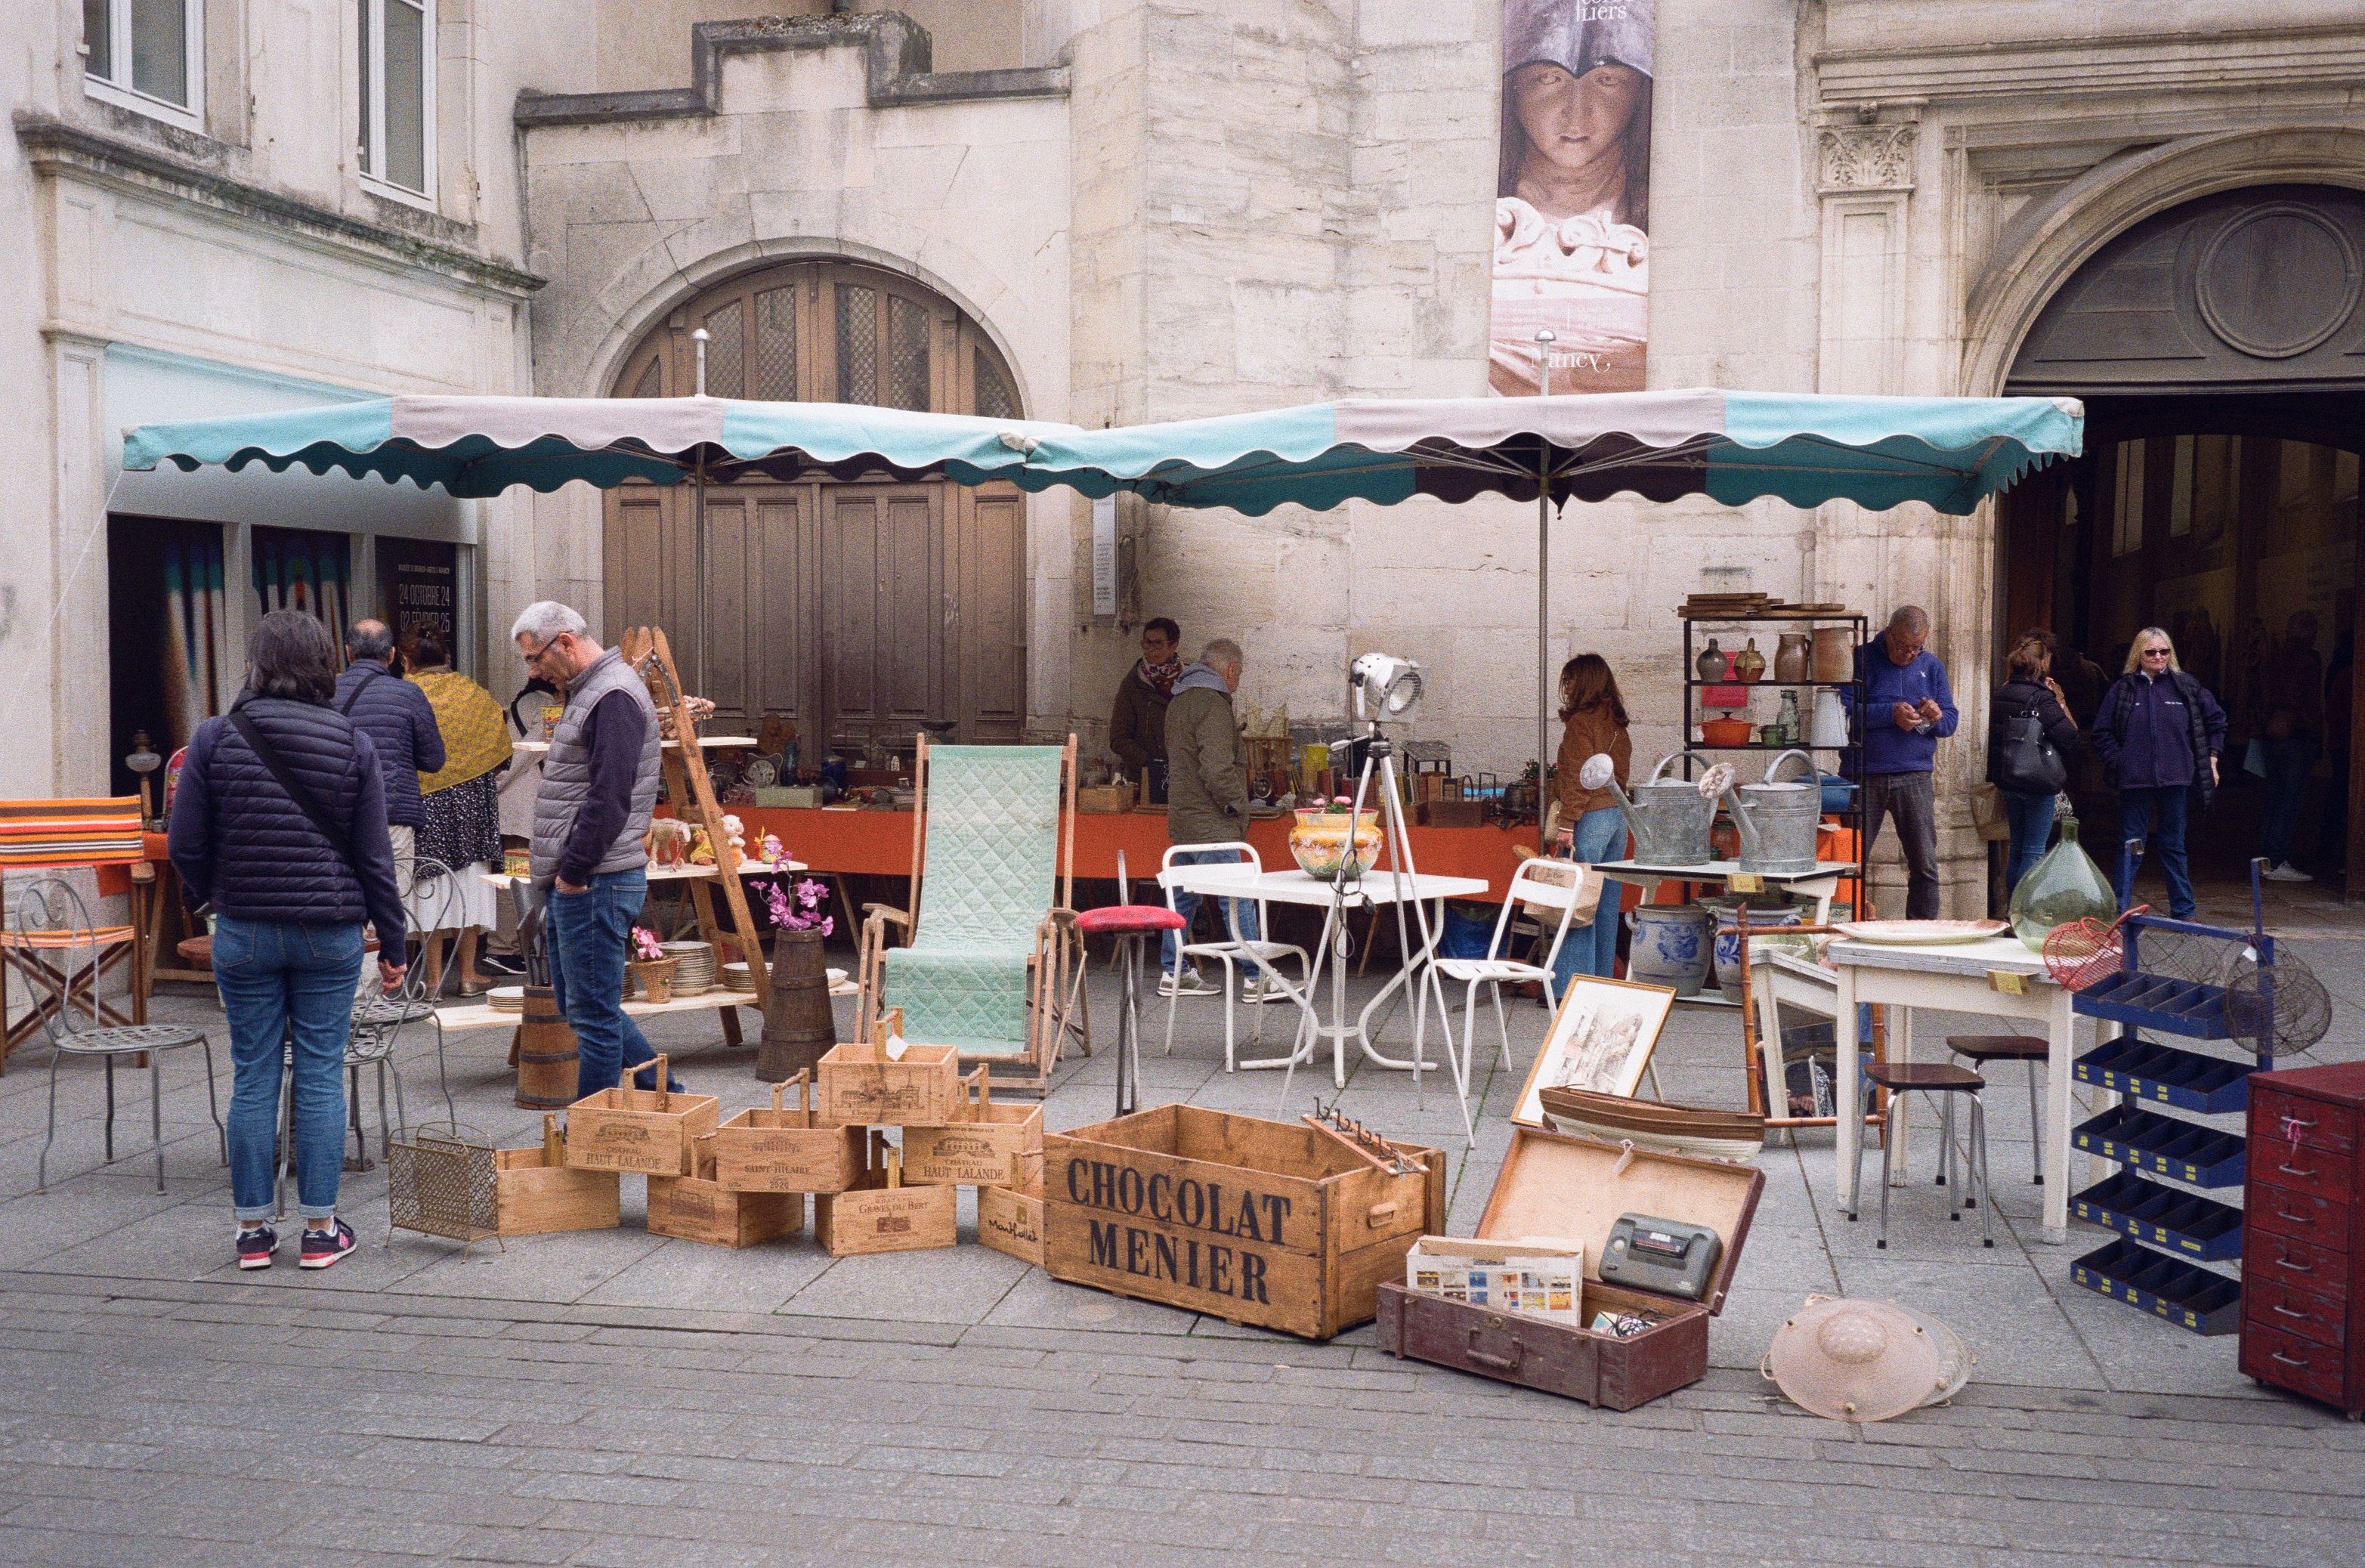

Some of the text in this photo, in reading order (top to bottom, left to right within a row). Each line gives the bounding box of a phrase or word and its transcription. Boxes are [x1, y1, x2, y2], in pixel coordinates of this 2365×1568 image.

[399, 584, 450, 607] 24 OCTOBRE 24
[441, 613, 450, 632] 25
[586, 1152, 662, 1170] HAUT LALANDE
[923, 1166, 1005, 1180] HAUT LALANDE
[1067, 1157, 1291, 1245] CHOCOLAT
[1089, 1218, 1271, 1306] MENIER
